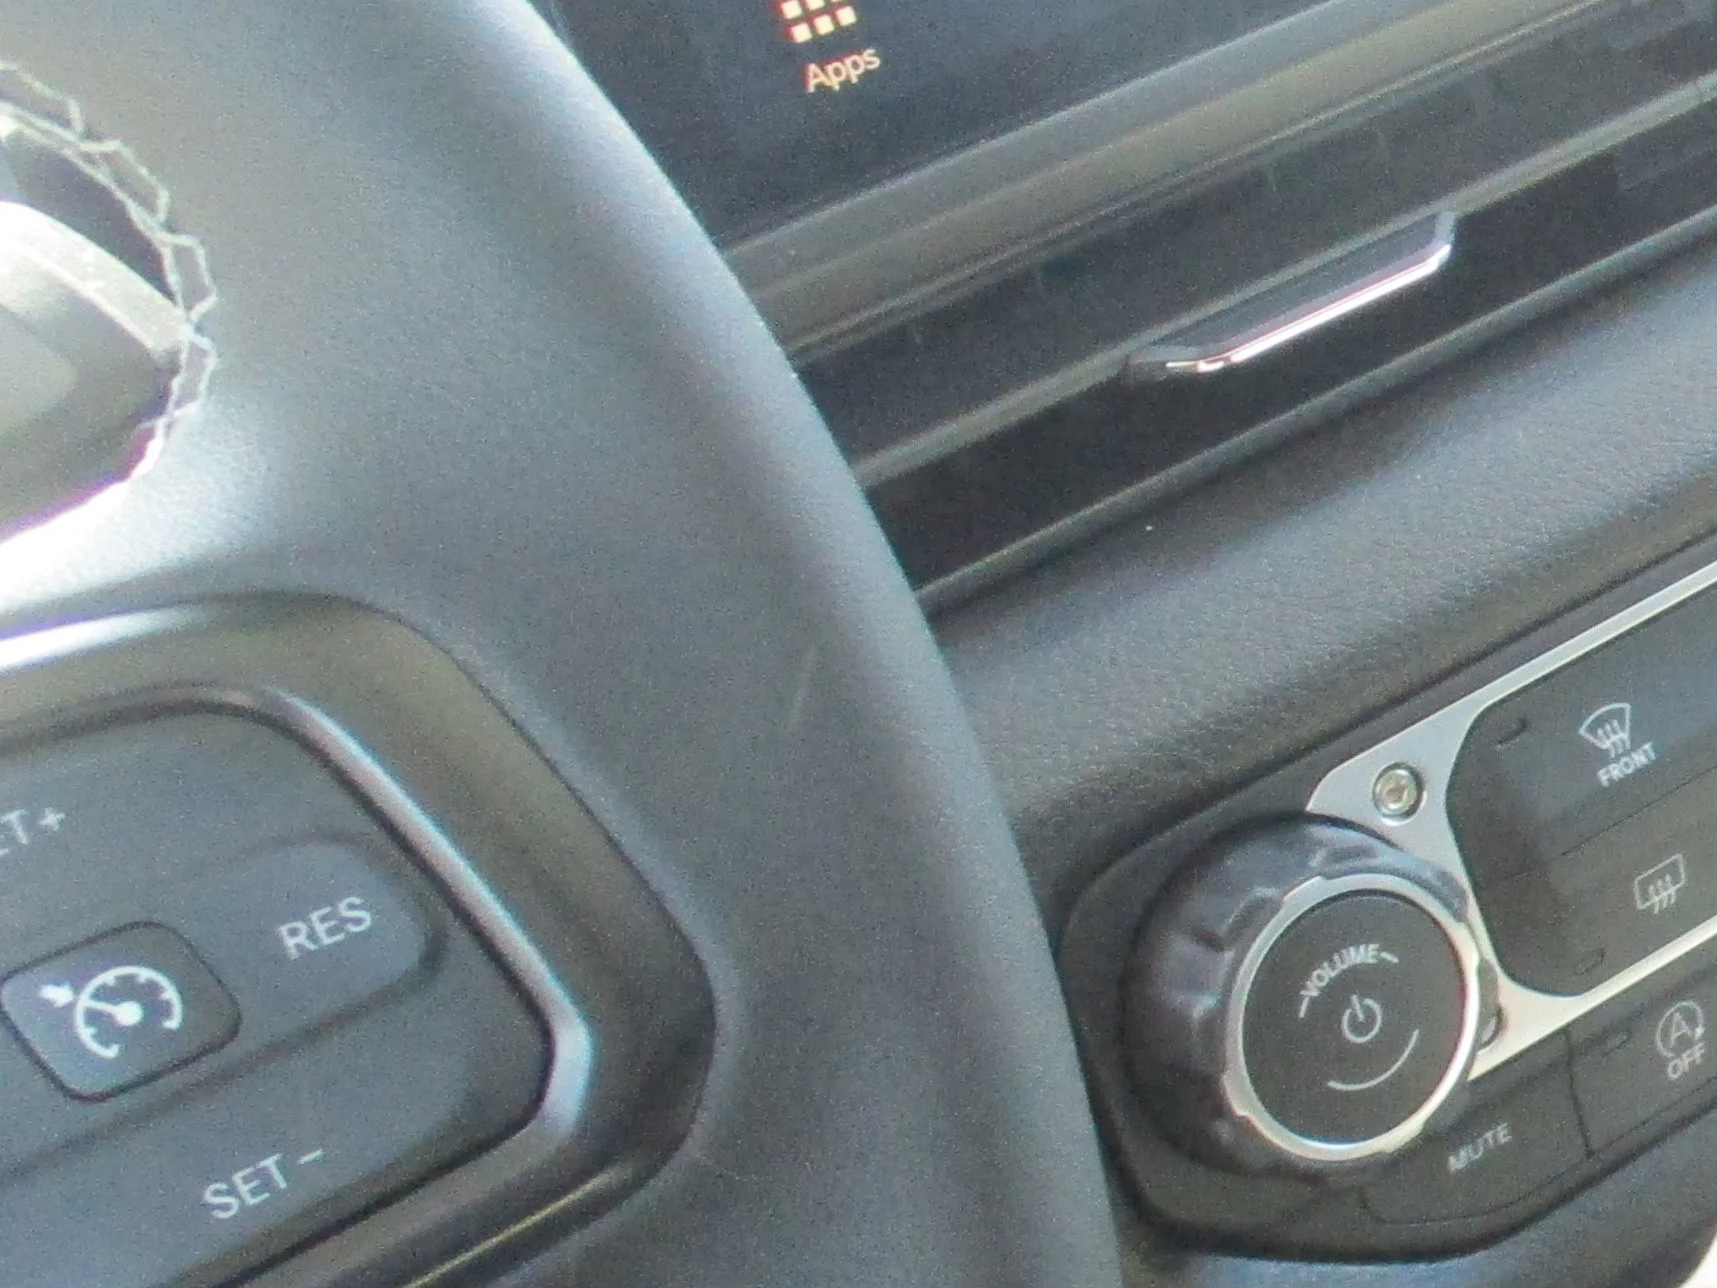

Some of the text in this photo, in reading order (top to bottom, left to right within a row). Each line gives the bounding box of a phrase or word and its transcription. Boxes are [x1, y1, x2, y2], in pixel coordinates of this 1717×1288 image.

[805, 48, 881, 93] Apps
[1597, 740, 1657, 789] FRONT
[277, 895, 374, 962] RES
[1300, 942, 1381, 998] VOLUME
[1667, 1040, 1706, 1081] OFF
[1445, 1121, 1514, 1174] MUTE
